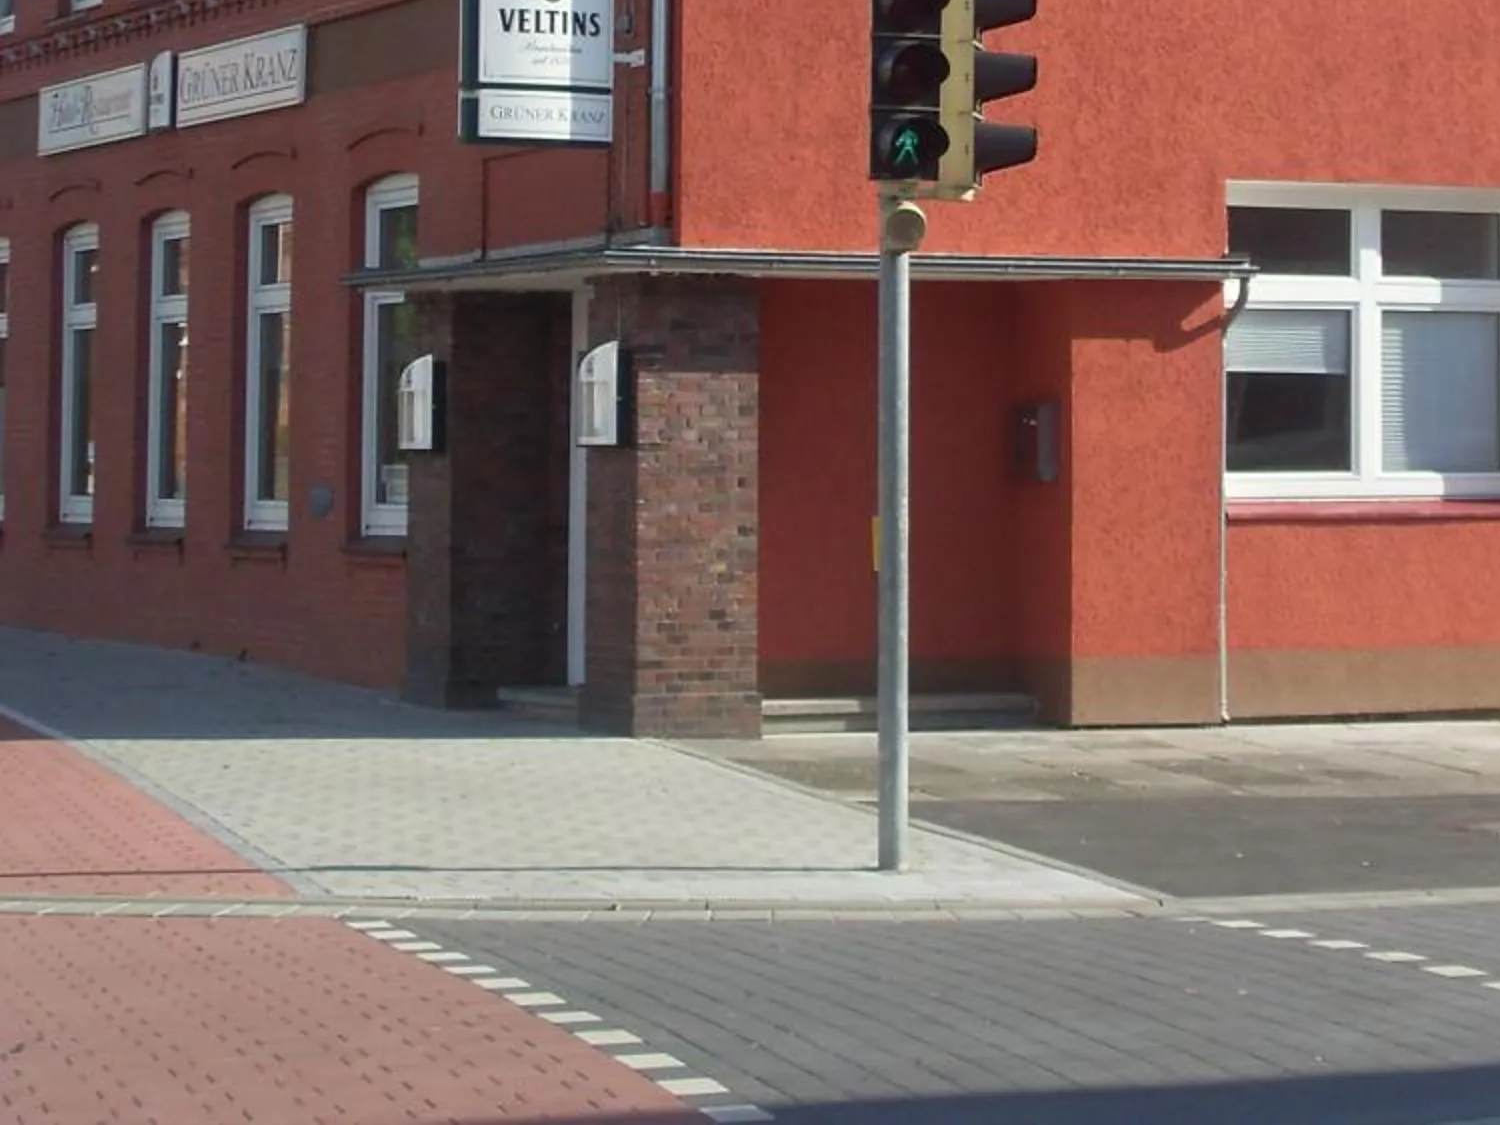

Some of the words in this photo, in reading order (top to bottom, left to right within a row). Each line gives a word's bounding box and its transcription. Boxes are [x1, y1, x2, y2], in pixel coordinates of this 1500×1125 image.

[499, 7, 601, 37] VELTINS
[180, 61, 240, 105] GRÜNER
[243, 48, 298, 90] KRANZ
